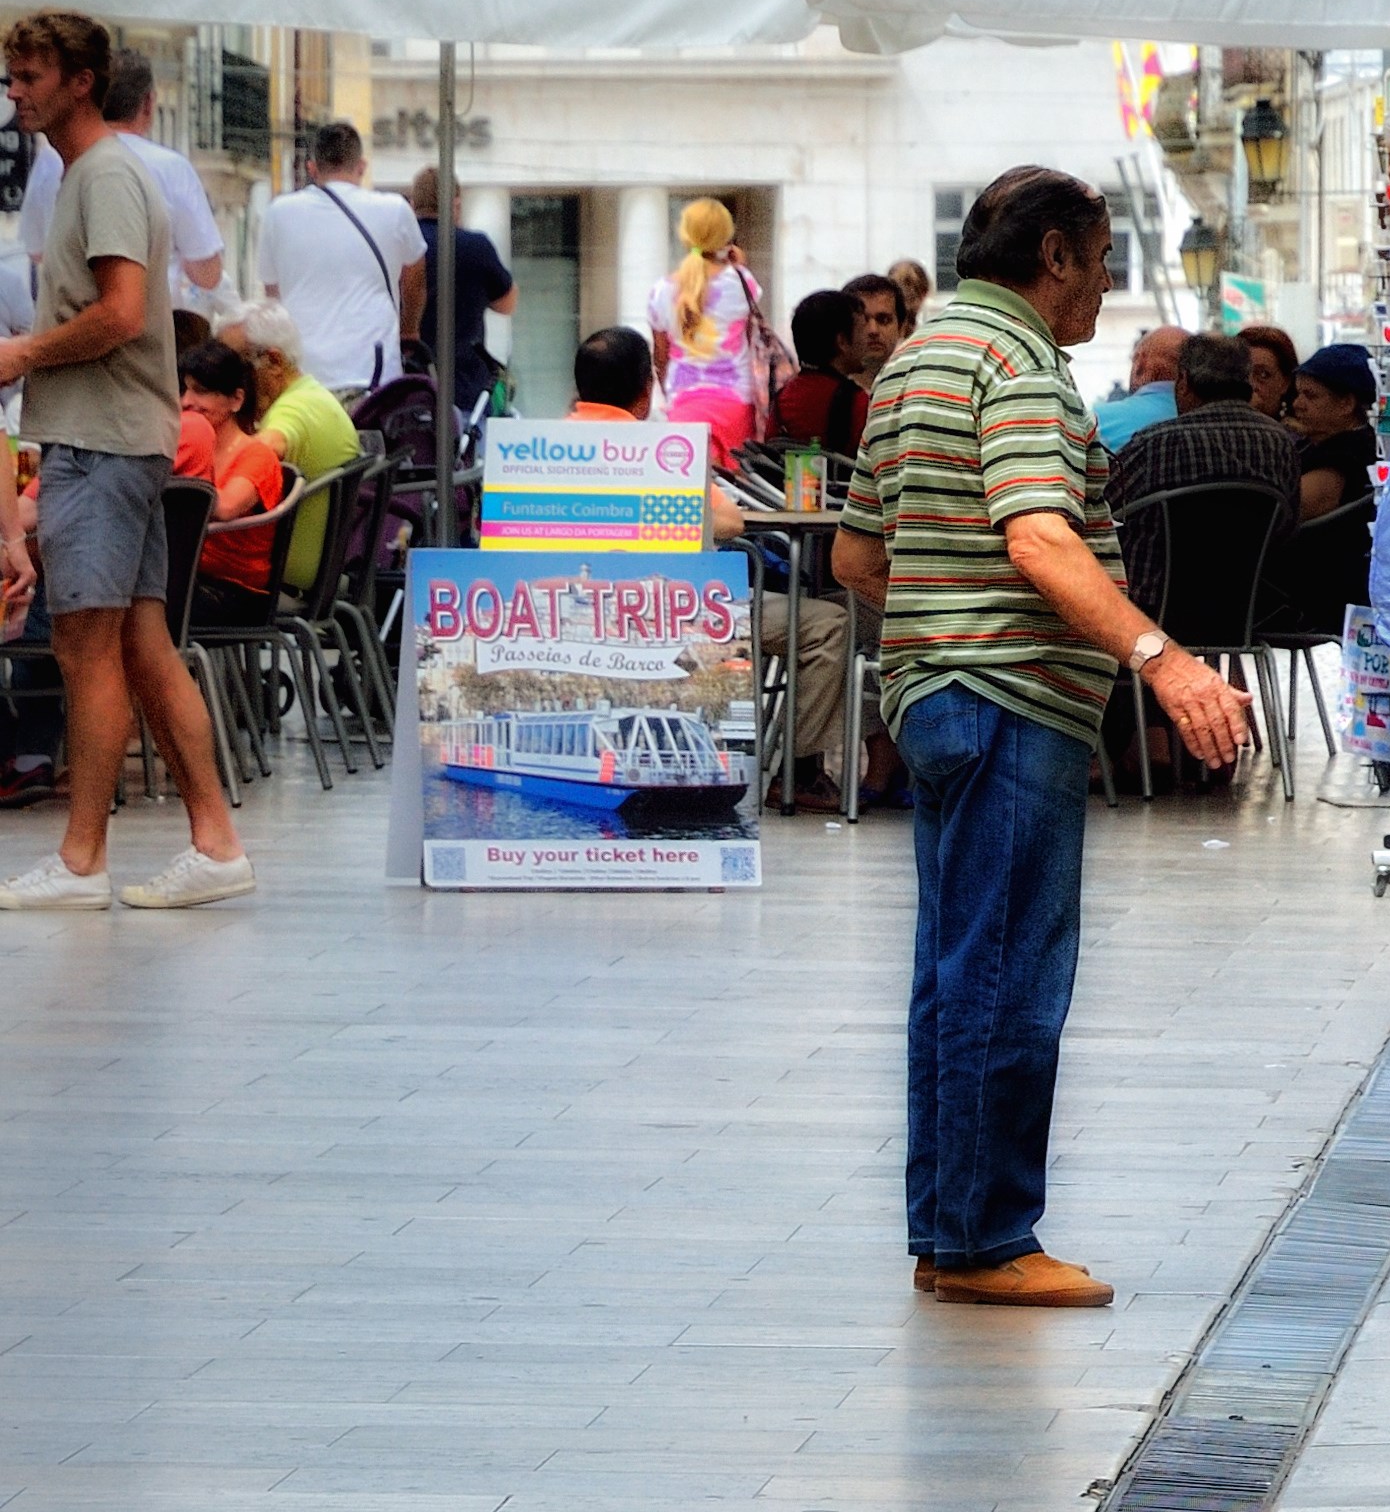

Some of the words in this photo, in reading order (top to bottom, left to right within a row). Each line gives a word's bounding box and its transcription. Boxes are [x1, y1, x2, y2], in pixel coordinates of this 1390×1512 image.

[603, 439, 649, 462] bus
[502, 465, 543, 474] OFFICIAL
[547, 466, 609, 476] SIGHTSEEING
[613, 467, 644, 476] TOURS
[502, 501, 567, 517] Funtastic
[572, 503, 634, 518] Coimbra
[502, 527, 520, 536] JOIN
[521, 528, 531, 536] US
[533, 528, 543, 536] AT
[545, 528, 573, 537] LARGO
[574, 528, 586, 537] DA
[588, 529, 632, 537] PORTAGEM
[429, 579, 573, 642] BOAT
[582, 579, 736, 644] TRIPS
[490, 644, 571, 664] Passeios
[578, 650, 602, 668] de
[606, 652, 666, 672] Barco
[487, 847, 526, 866] Buy
[533, 849, 579, 866] your
[586, 847, 646, 863] ticket
[652, 847, 699, 863] here
